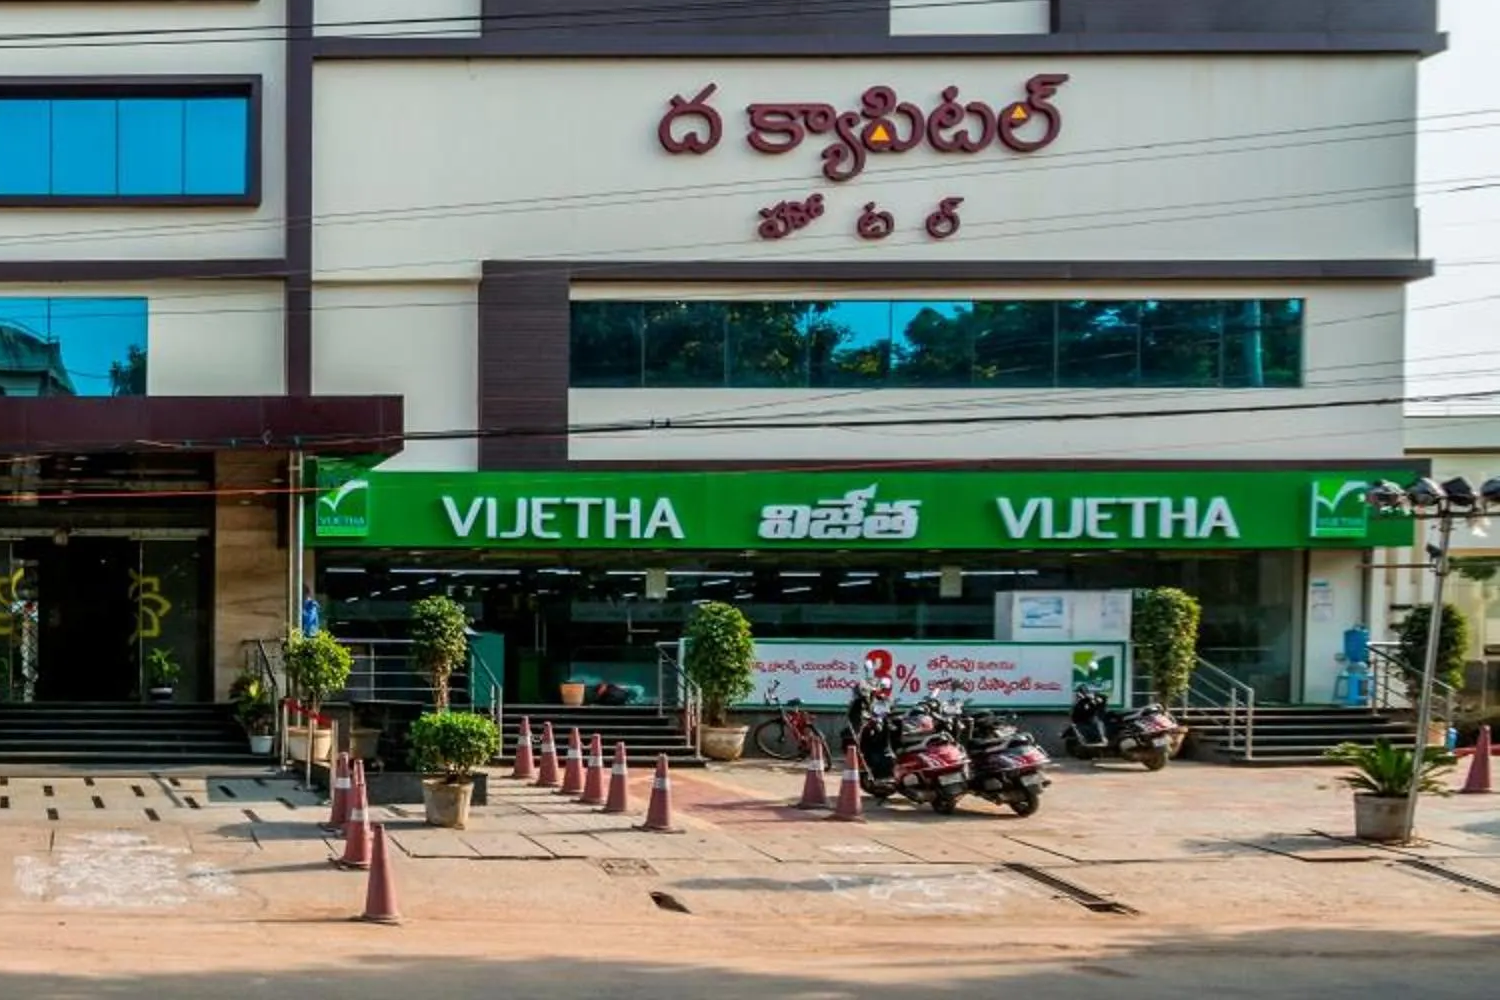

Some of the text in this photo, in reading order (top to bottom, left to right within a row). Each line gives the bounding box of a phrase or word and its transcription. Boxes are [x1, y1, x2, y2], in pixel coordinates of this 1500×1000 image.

[658, 73, 1069, 182] ద క్యాపిటల్
[442, 496, 685, 539] VIJETHA
[757, 482, 923, 539] విజేత
[996, 496, 1240, 540] VIJETHA
